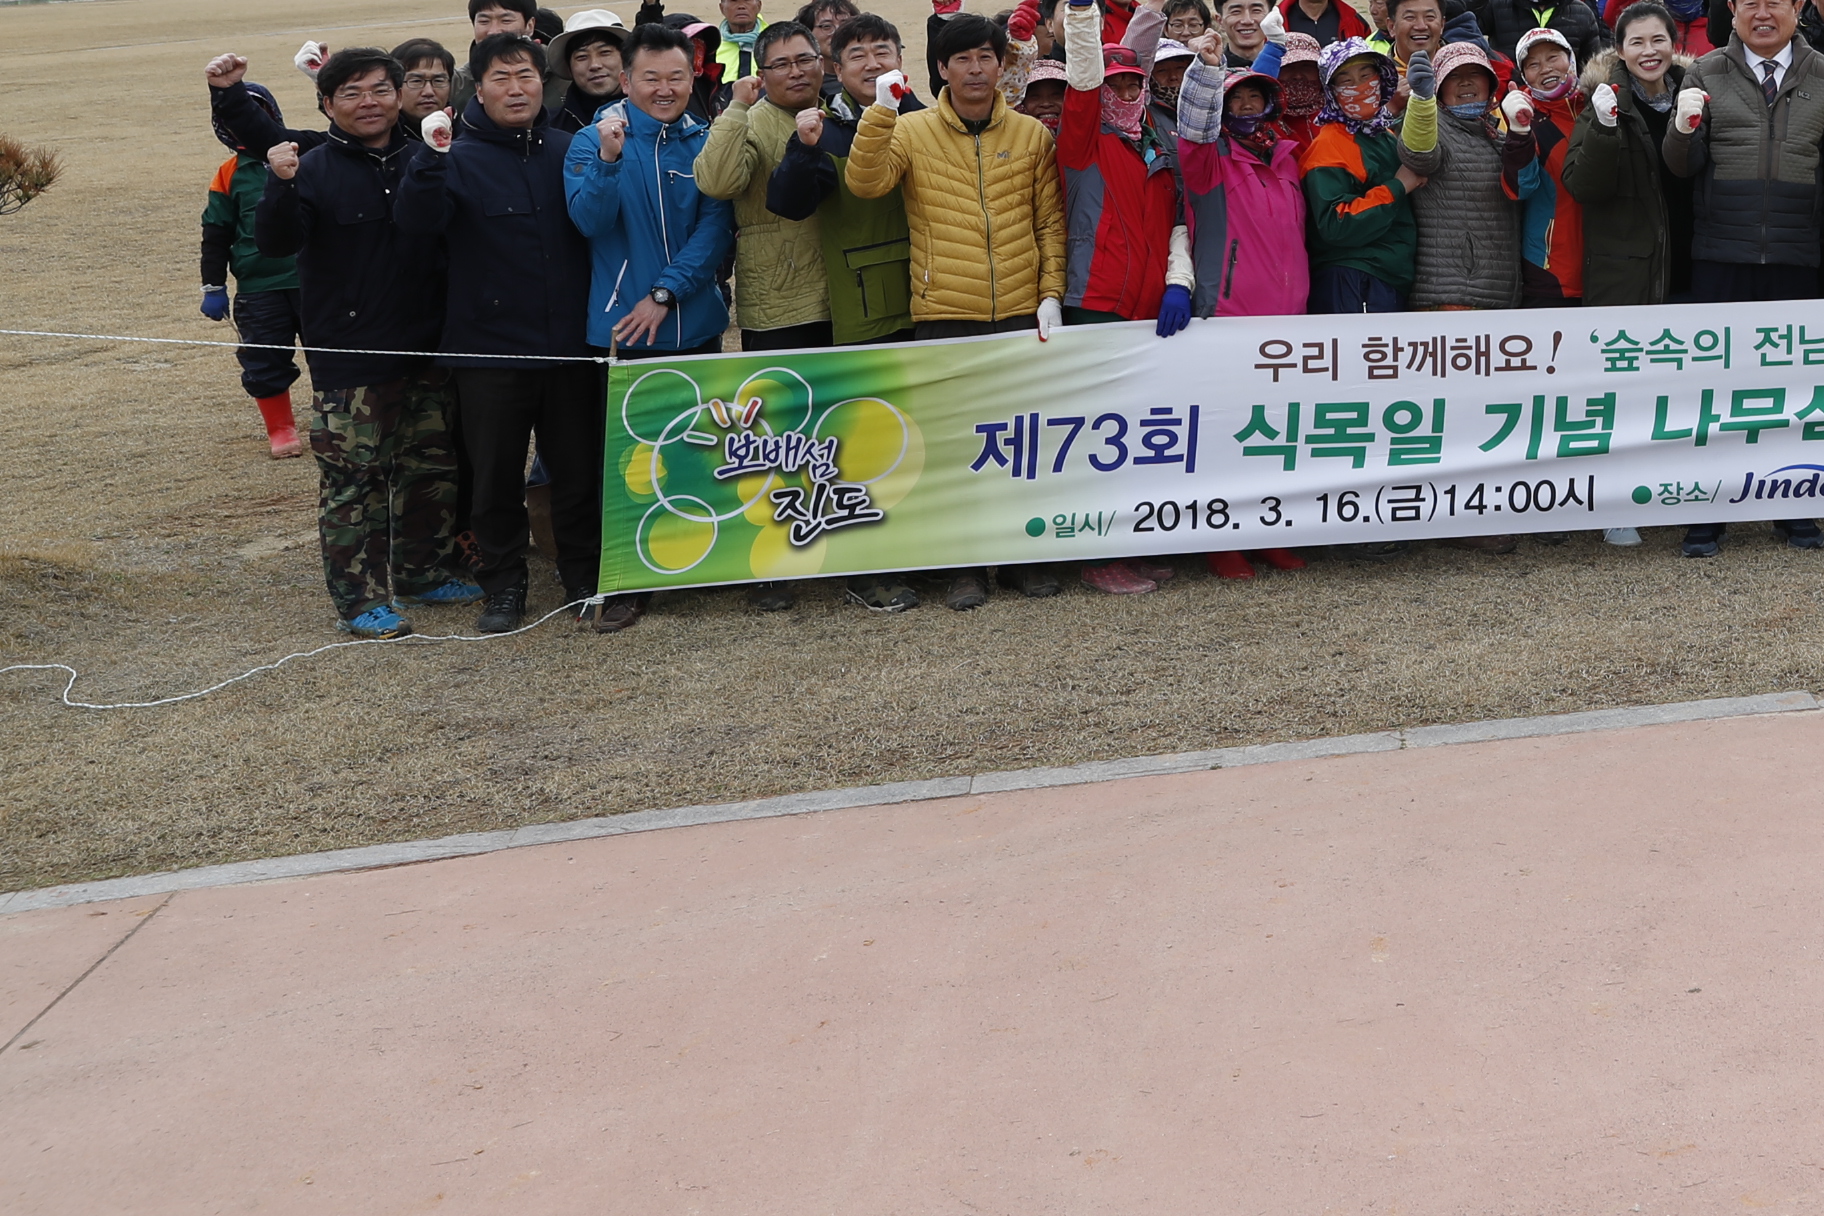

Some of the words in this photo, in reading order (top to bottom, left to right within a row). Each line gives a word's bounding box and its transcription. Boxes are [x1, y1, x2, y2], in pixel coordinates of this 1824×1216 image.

[1253, 337, 1340, 383] 우리
[1361, 330, 1564, 380] 함께해요!
[1589, 327, 1734, 372] ‘숲속의
[714, 431, 838, 481] 보배섬
[969, 404, 1201, 480] 제73회
[1233, 396, 1447, 472] 식목일
[1478, 391, 1617, 461] 기념
[770, 482, 884, 544] 진도
[1052, 510, 1117, 539] 일시/
[1132, 498, 1241, 533] 2018.
[1259, 496, 1294, 527] 3.
[1656, 479, 1723, 506] 장소/
